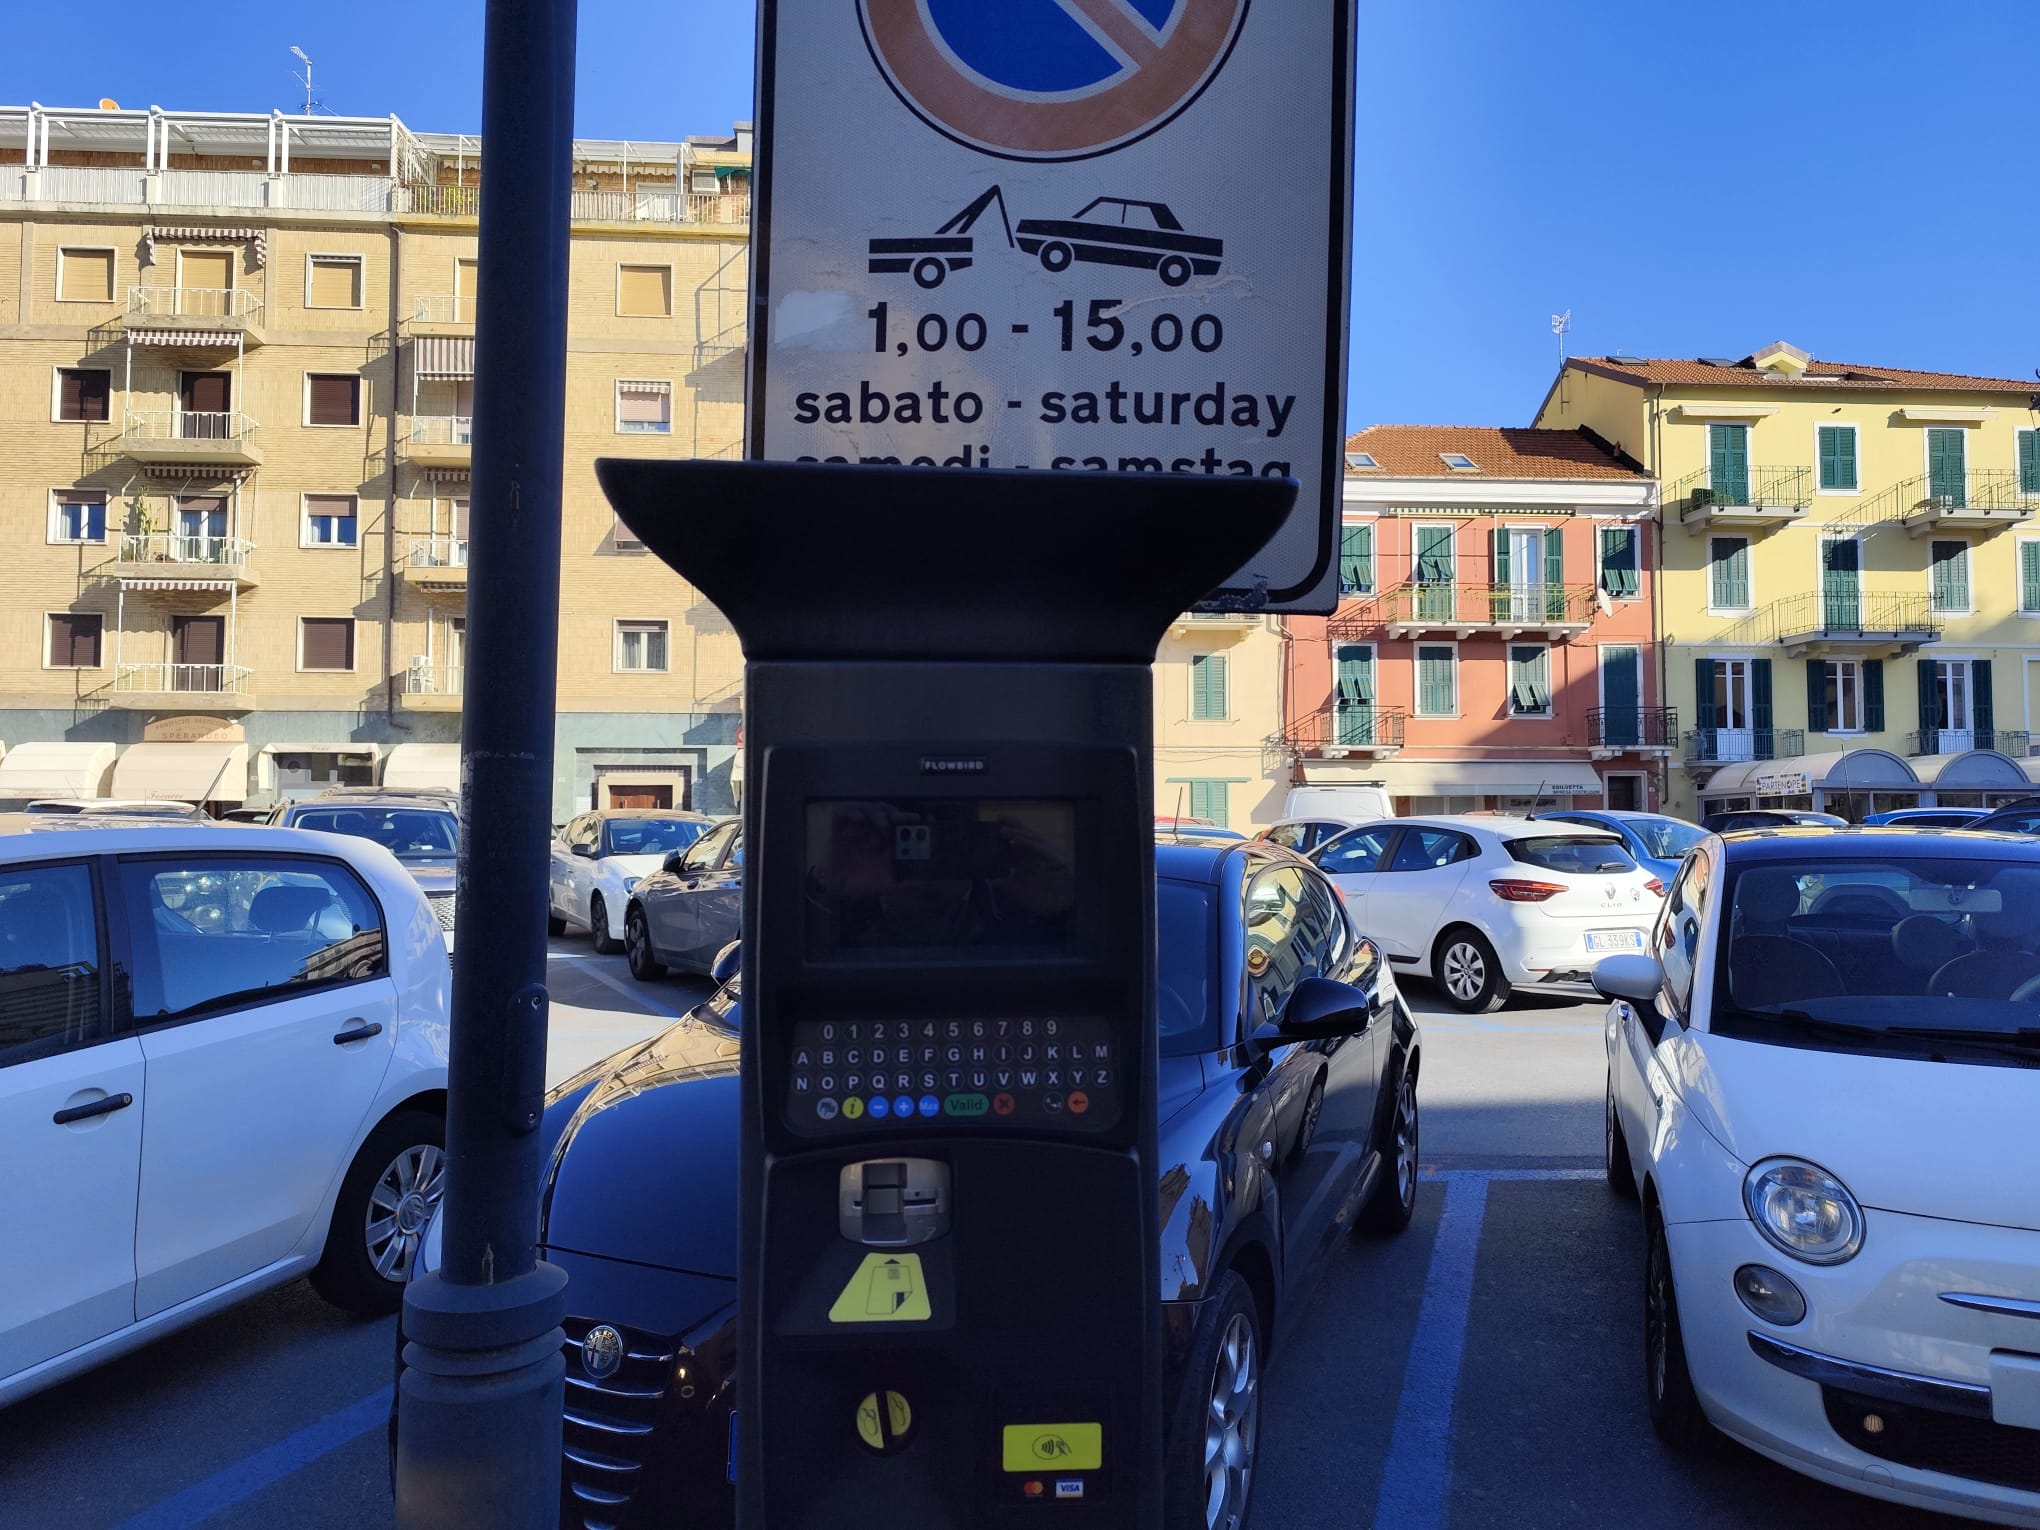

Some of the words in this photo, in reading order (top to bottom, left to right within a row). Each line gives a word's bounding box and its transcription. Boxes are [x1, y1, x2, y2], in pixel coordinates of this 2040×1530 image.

[868, 301, 987, 357] 1,00
[1012, 324, 1028, 334] -
[1053, 299, 1223, 357] 15,00
[794, 380, 983, 424] sabato
[1008, 400, 1022, 408] -
[1040, 381, 1297, 438] saturday
[924, 760, 984, 770] FLOWBIRD
[823, 1025, 834, 1040] 0
[874, 1024, 884, 1039] 2
[899, 1024, 909, 1038] 3
[923, 1024, 934, 1037] 4
[949, 1023, 959, 1037] 5
[973, 1023, 984, 1037] 6
[998, 1022, 1008, 1036] 7
[1022, 1021, 1033, 1036] 8
[1046, 1021, 1057, 1035] 9
[797, 1052, 809, 1065] A
[823, 1052, 834, 1064] B
[848, 1051, 859, 1064] C
[873, 1050, 885, 1063] D
[899, 1050, 909, 1062] E
[924, 1049, 934, 1062] F
[948, 1049, 960, 1061] G
[973, 1049, 984, 1061] H
[1023, 1048, 1032, 1060] J
[1047, 1047, 1058, 1059] K
[1072, 1046, 1082, 1059] L
[1095, 1046, 1108, 1058] M
[796, 1078, 808, 1090] N
[821, 1077, 834, 1090] O
[848, 1077, 859, 1089] P
[872, 1076, 885, 1089] Q
[898, 1075, 909, 1088] R
[924, 1075, 934, 1087] S
[949, 1074, 959, 1086] T
[973, 1074, 984, 1086] U
[998, 1073, 1009, 1085] V
[1021, 1073, 1036, 1085] W
[1048, 1072, 1058, 1084] X
[1072, 1072, 1083, 1084] Y
[1097, 1071, 1107, 1084] Z
[950, 1098, 983, 1111] Valid
[1060, 1484, 1080, 1492] VISA
